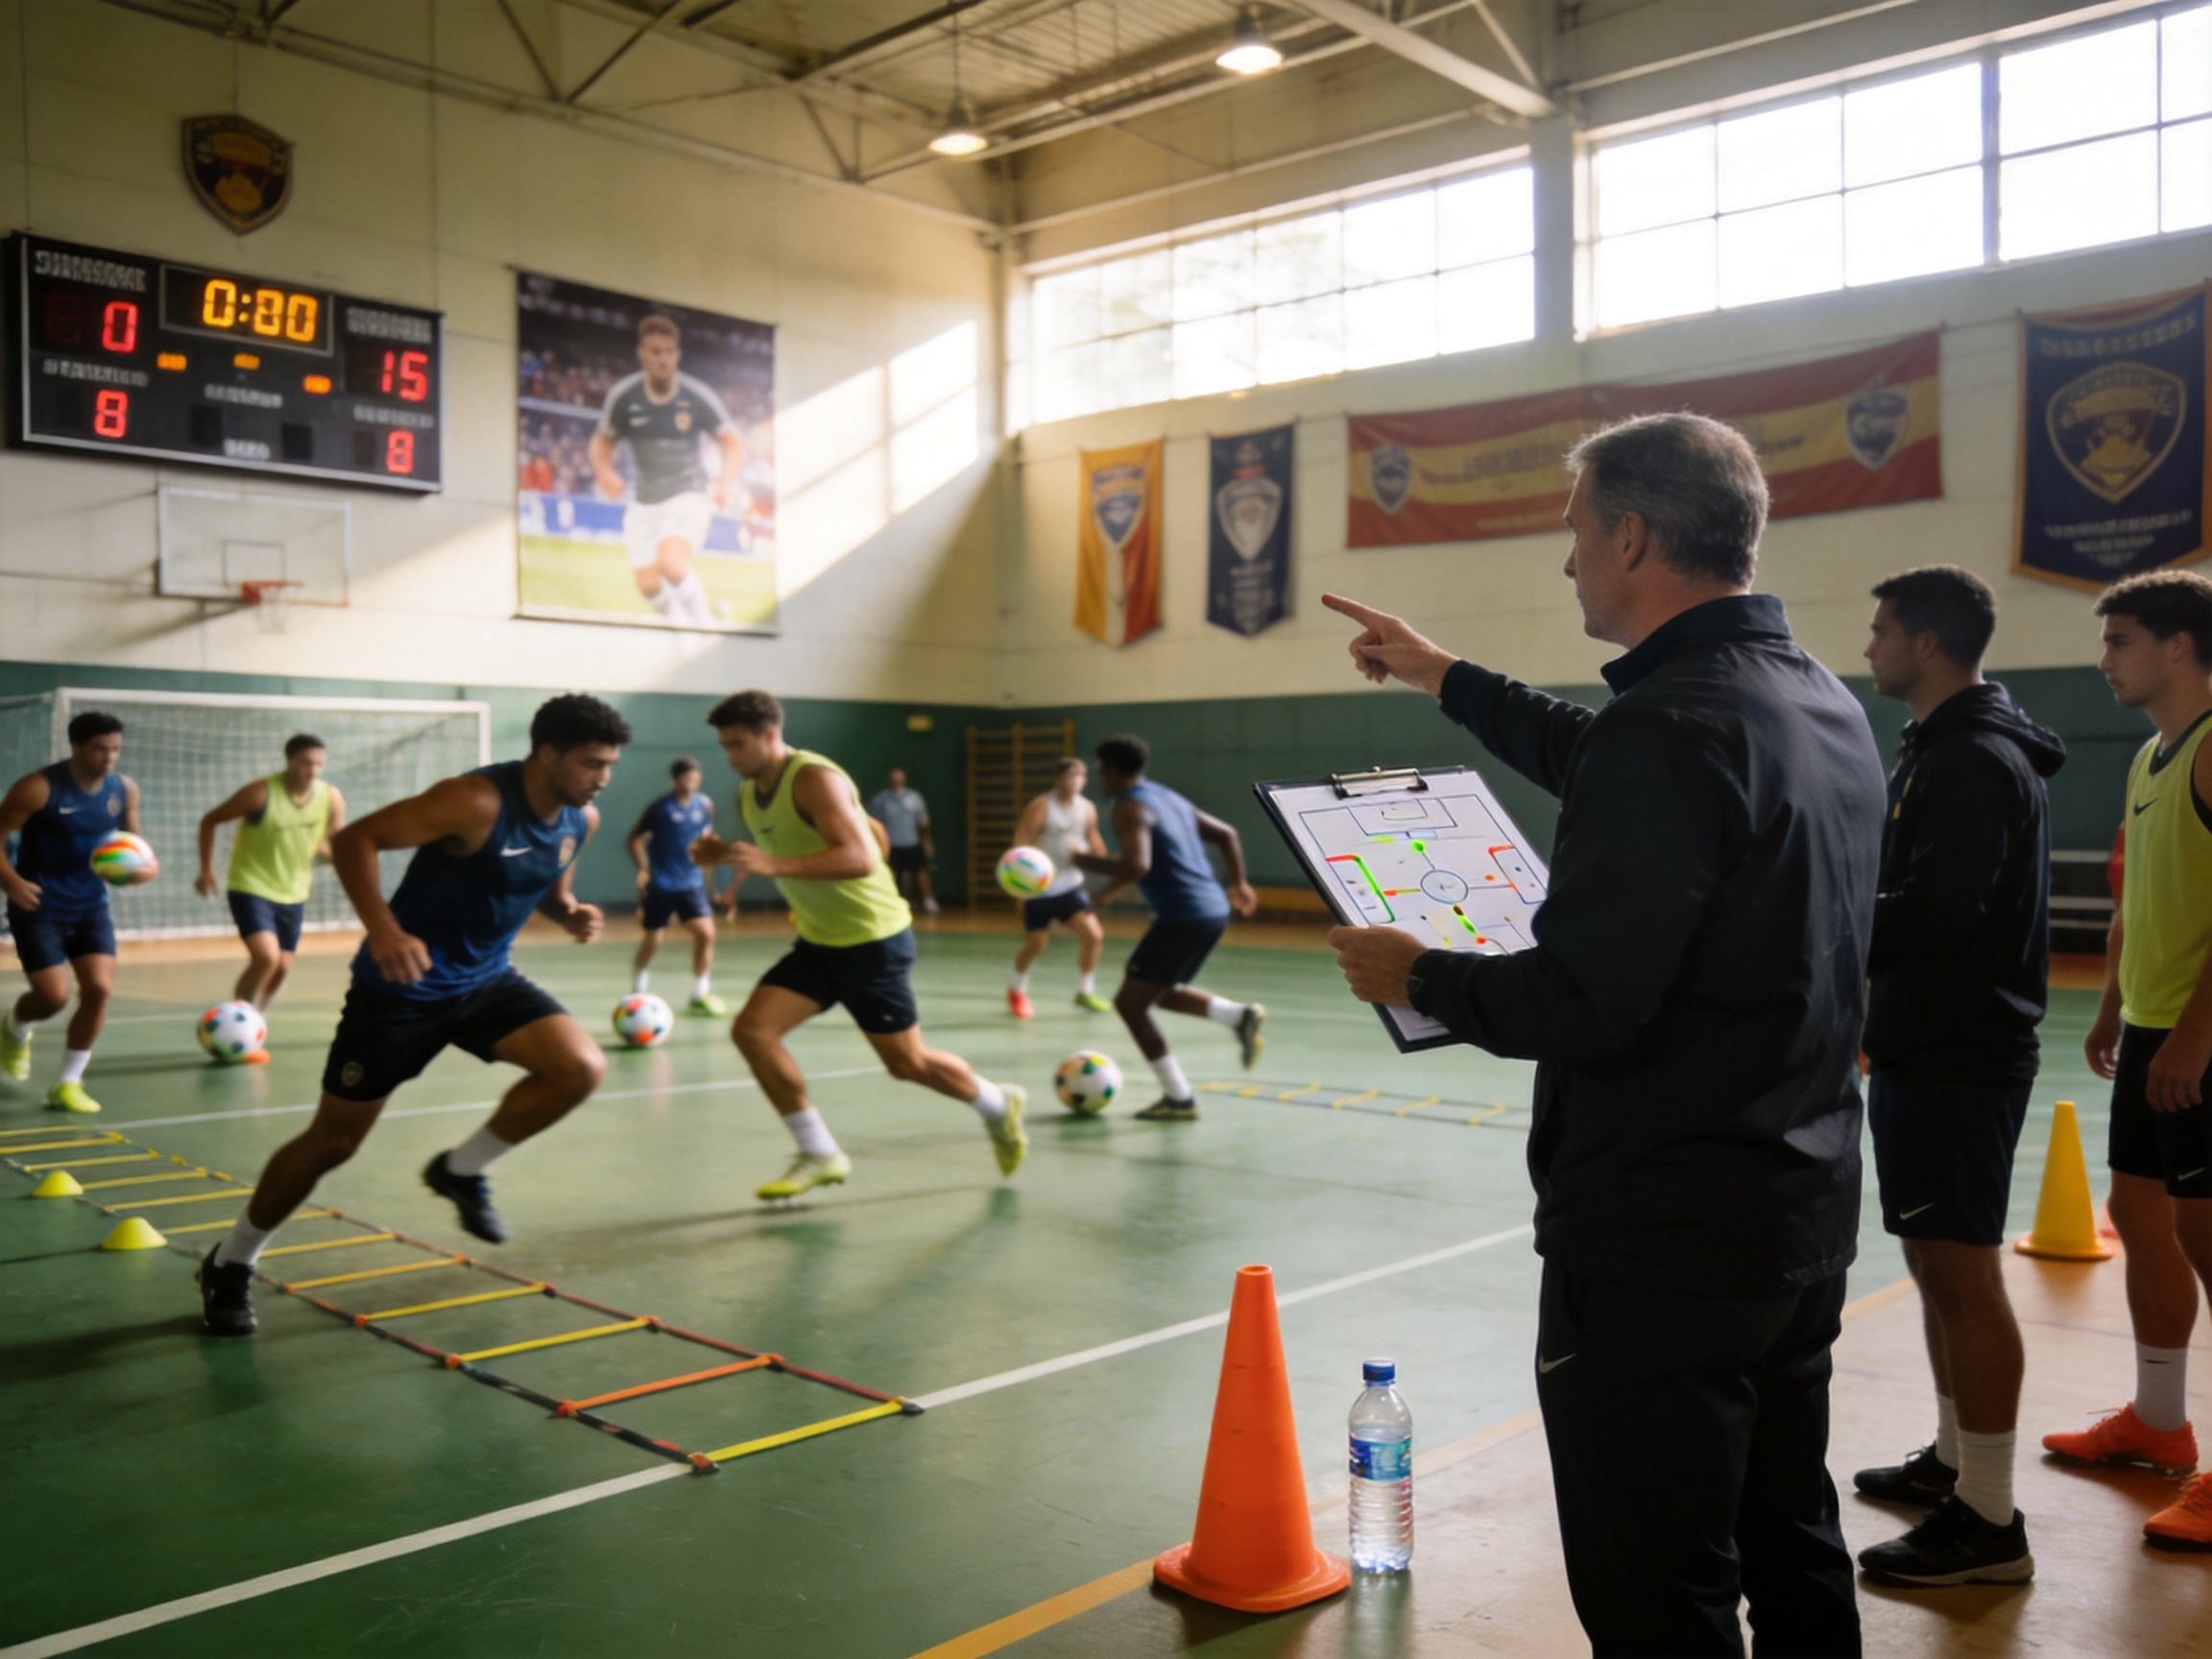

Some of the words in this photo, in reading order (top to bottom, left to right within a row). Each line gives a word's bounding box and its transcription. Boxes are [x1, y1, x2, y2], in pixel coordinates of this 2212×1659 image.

[102, 301, 138, 353] 0
[382, 350, 429, 401] 15
[94, 390, 129, 439] 8
[387, 429, 415, 473] 8
